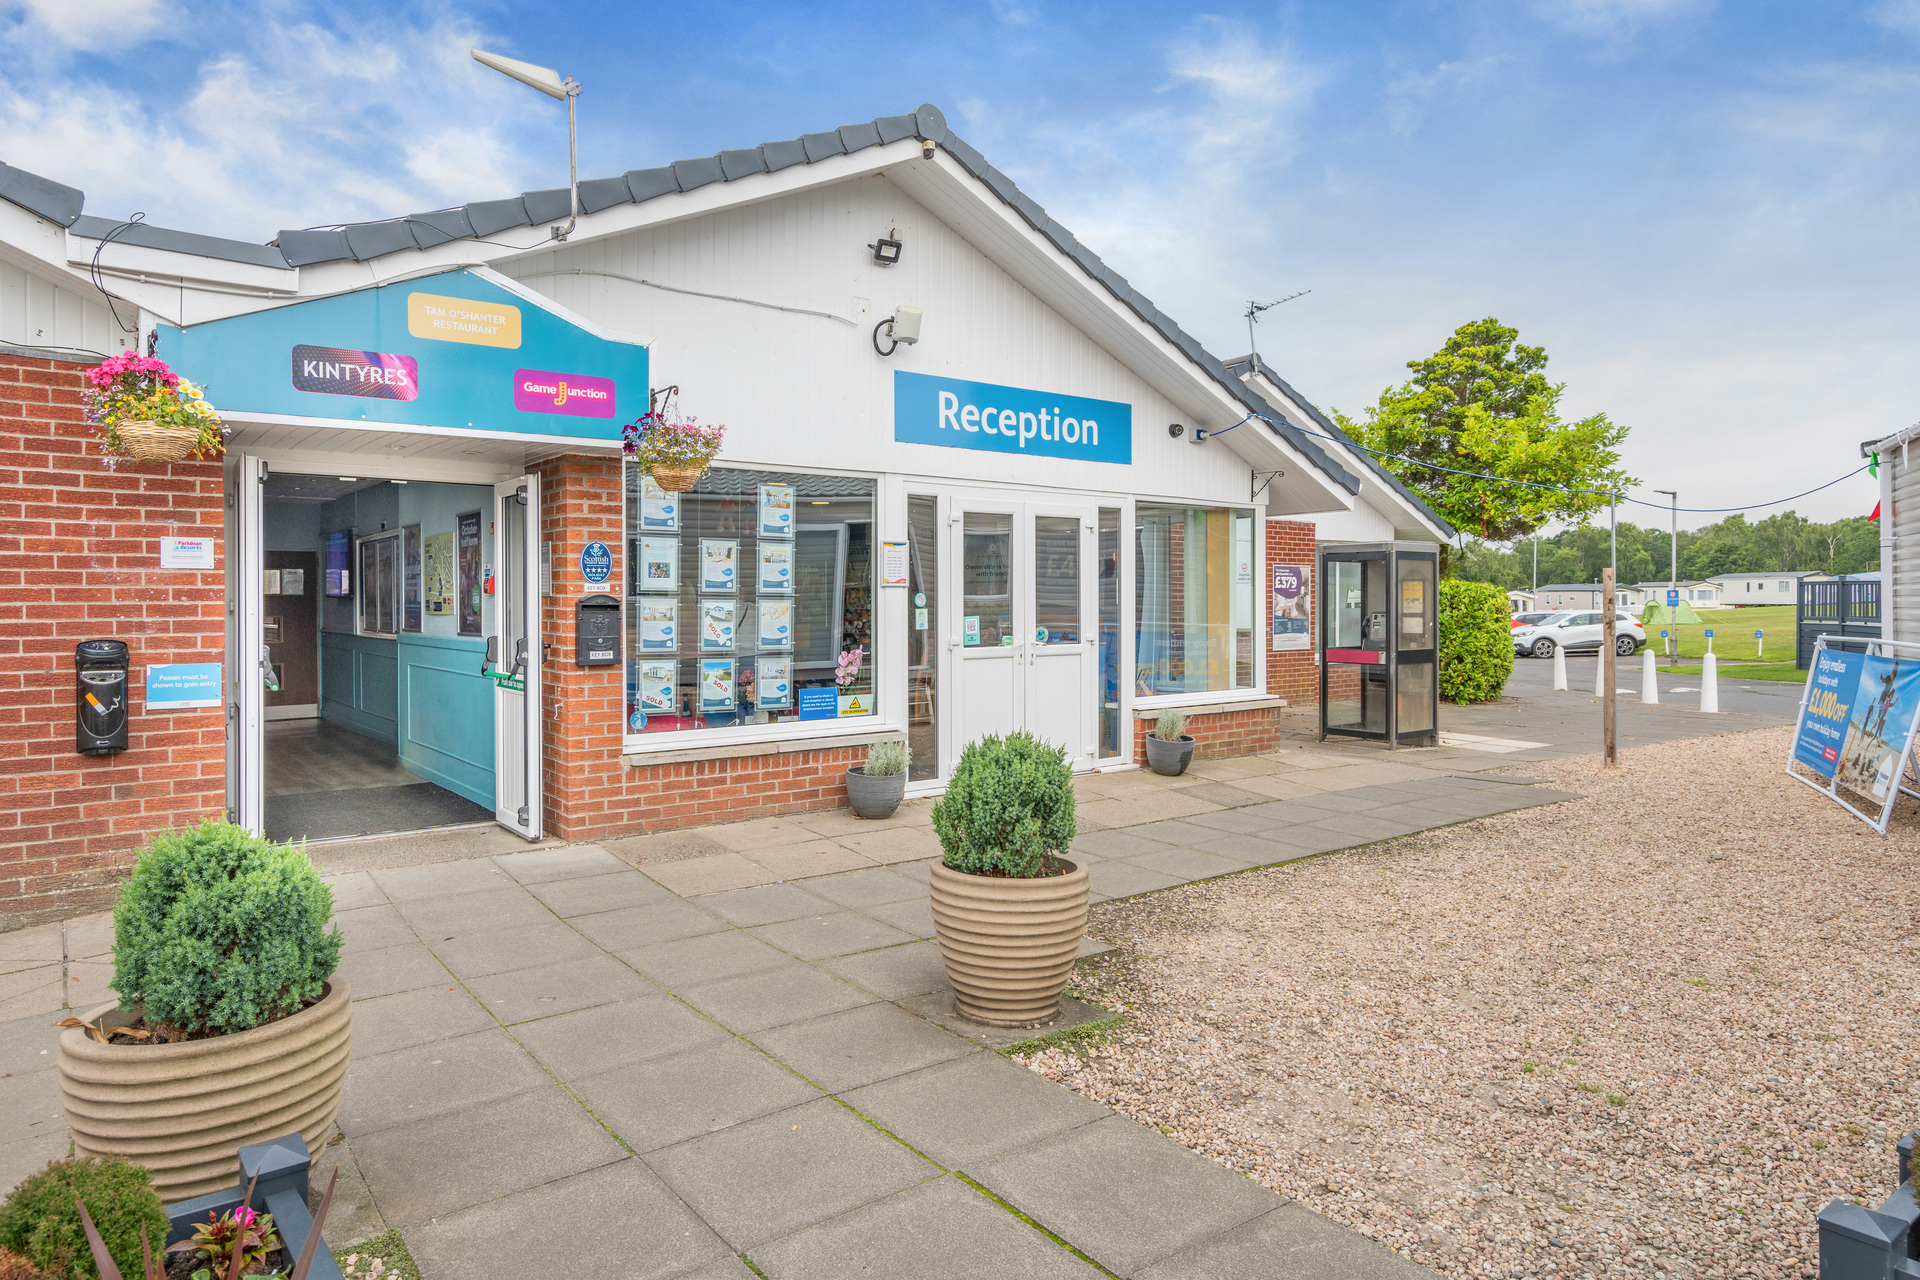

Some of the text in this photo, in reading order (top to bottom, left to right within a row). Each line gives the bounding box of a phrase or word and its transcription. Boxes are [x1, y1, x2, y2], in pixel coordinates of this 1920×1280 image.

[424, 305, 506, 325] TAM O'SHANTER
[433, 319, 498, 336] RESTAURANT
[303, 360, 408, 386] KINTYRES
[523, 381, 607, 405] Game Junction
[938, 390, 1099, 448] Reception
[1275, 576, 1297, 589] £379
[708, 622, 720, 639] SOLD
[1819, 656, 1846, 673] Enjoy endless
[713, 680, 728, 693] SOLD
[646, 695, 663, 706] SOLD
[1808, 688, 1838, 718] £1,000
